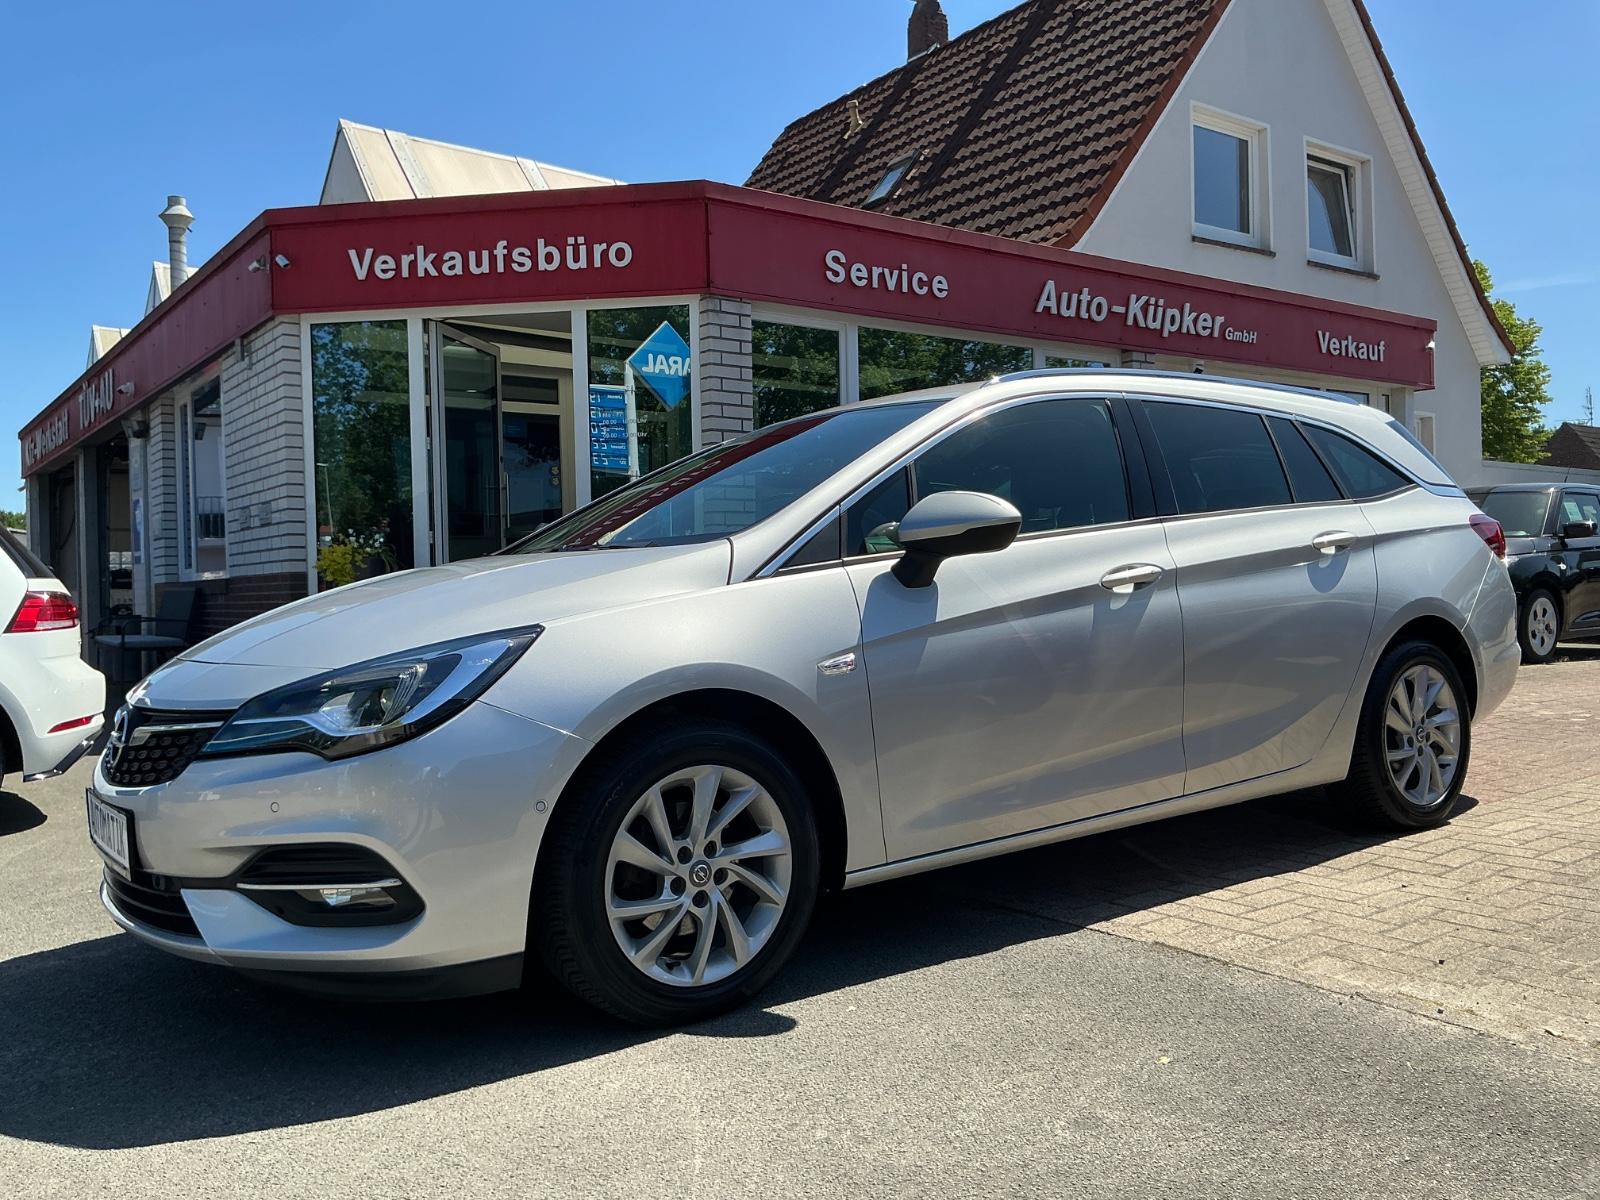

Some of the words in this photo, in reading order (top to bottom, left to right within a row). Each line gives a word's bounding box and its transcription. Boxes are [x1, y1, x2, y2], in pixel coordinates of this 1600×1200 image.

[347, 236, 633, 281] Verkaufsbüro
[824, 250, 949, 299] Service
[1035, 280, 1225, 338] Auto-Küpker
[1225, 327, 1258, 344] GmbH
[1317, 330, 1386, 364] Verkauf
